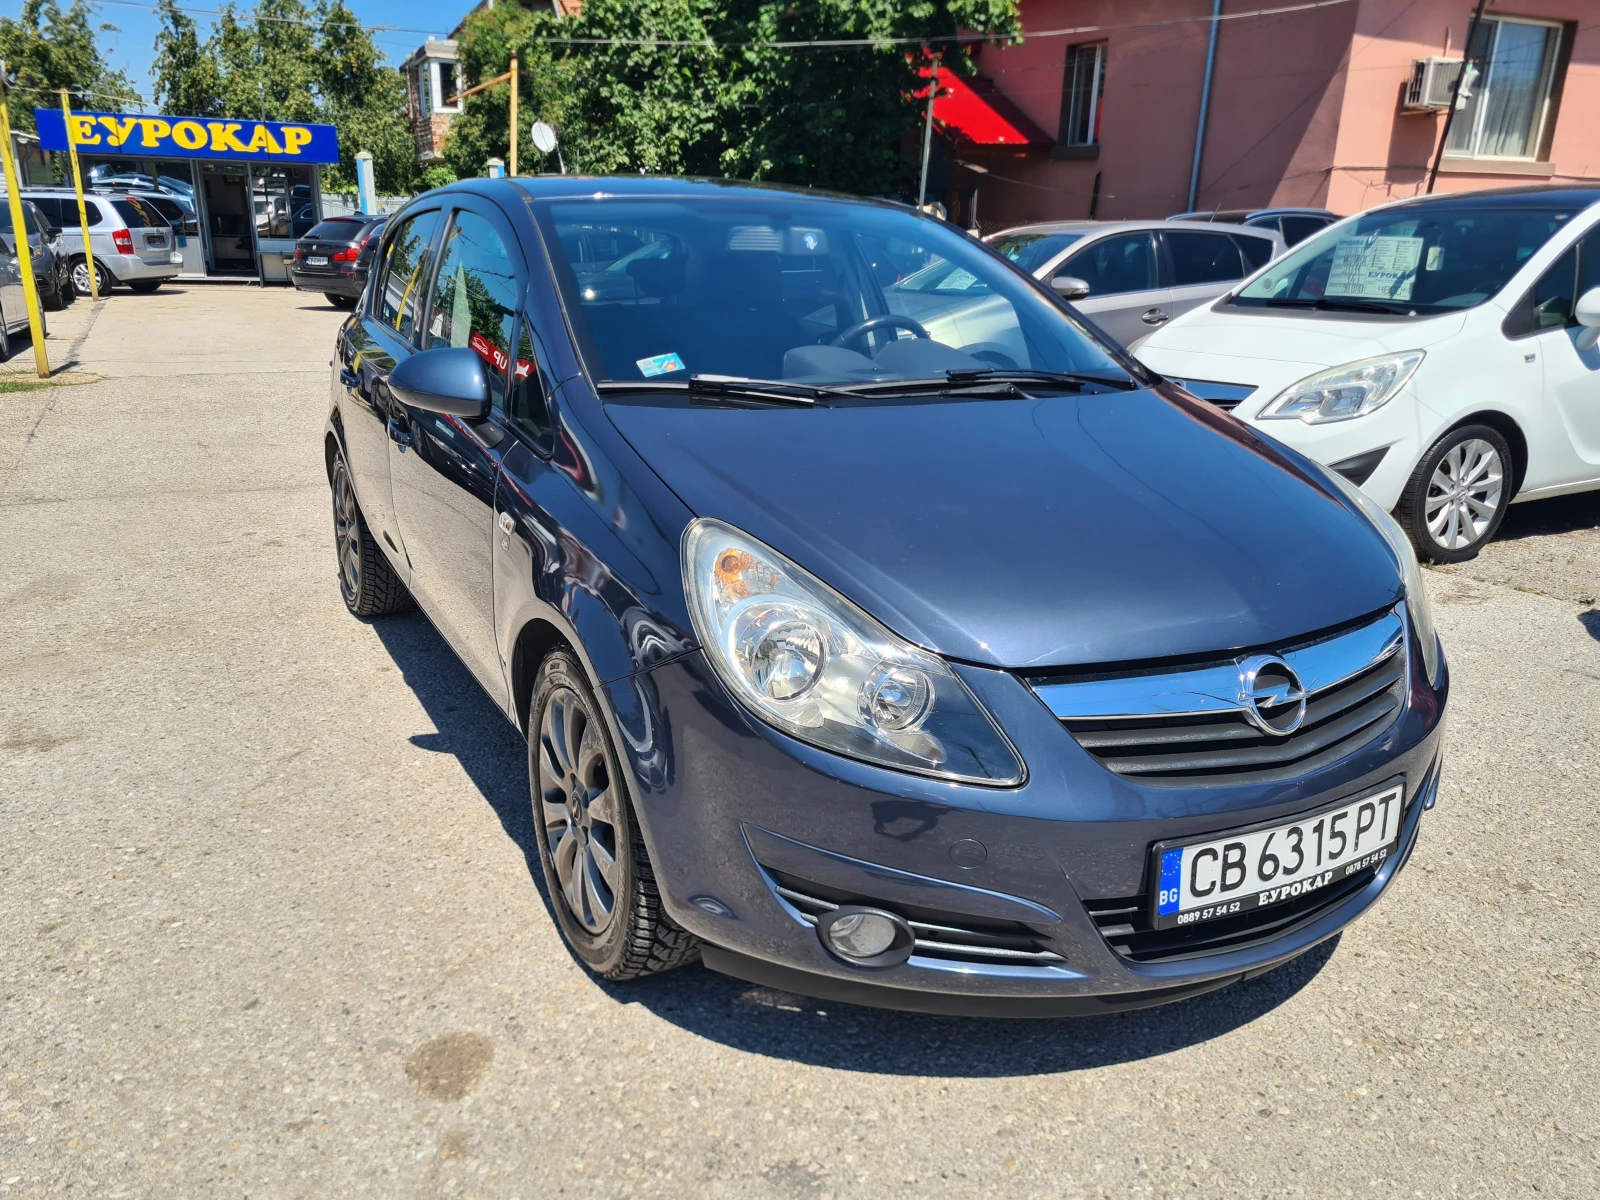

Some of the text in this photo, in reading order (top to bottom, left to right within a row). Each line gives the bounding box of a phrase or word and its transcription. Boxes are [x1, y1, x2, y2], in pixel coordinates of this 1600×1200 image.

[71, 115, 312, 155] ЕУРОКАР
[1257, 811, 1349, 882] 6315
[1345, 864, 1361, 876] 0878
[1361, 858, 1370, 868] 57
[1379, 848, 1387, 859] 52
[1159, 887, 1178, 906] BG
[1258, 871, 1333, 906] ЕУРОКАР
[1177, 901, 1240, 925] 0889 57 54 52
